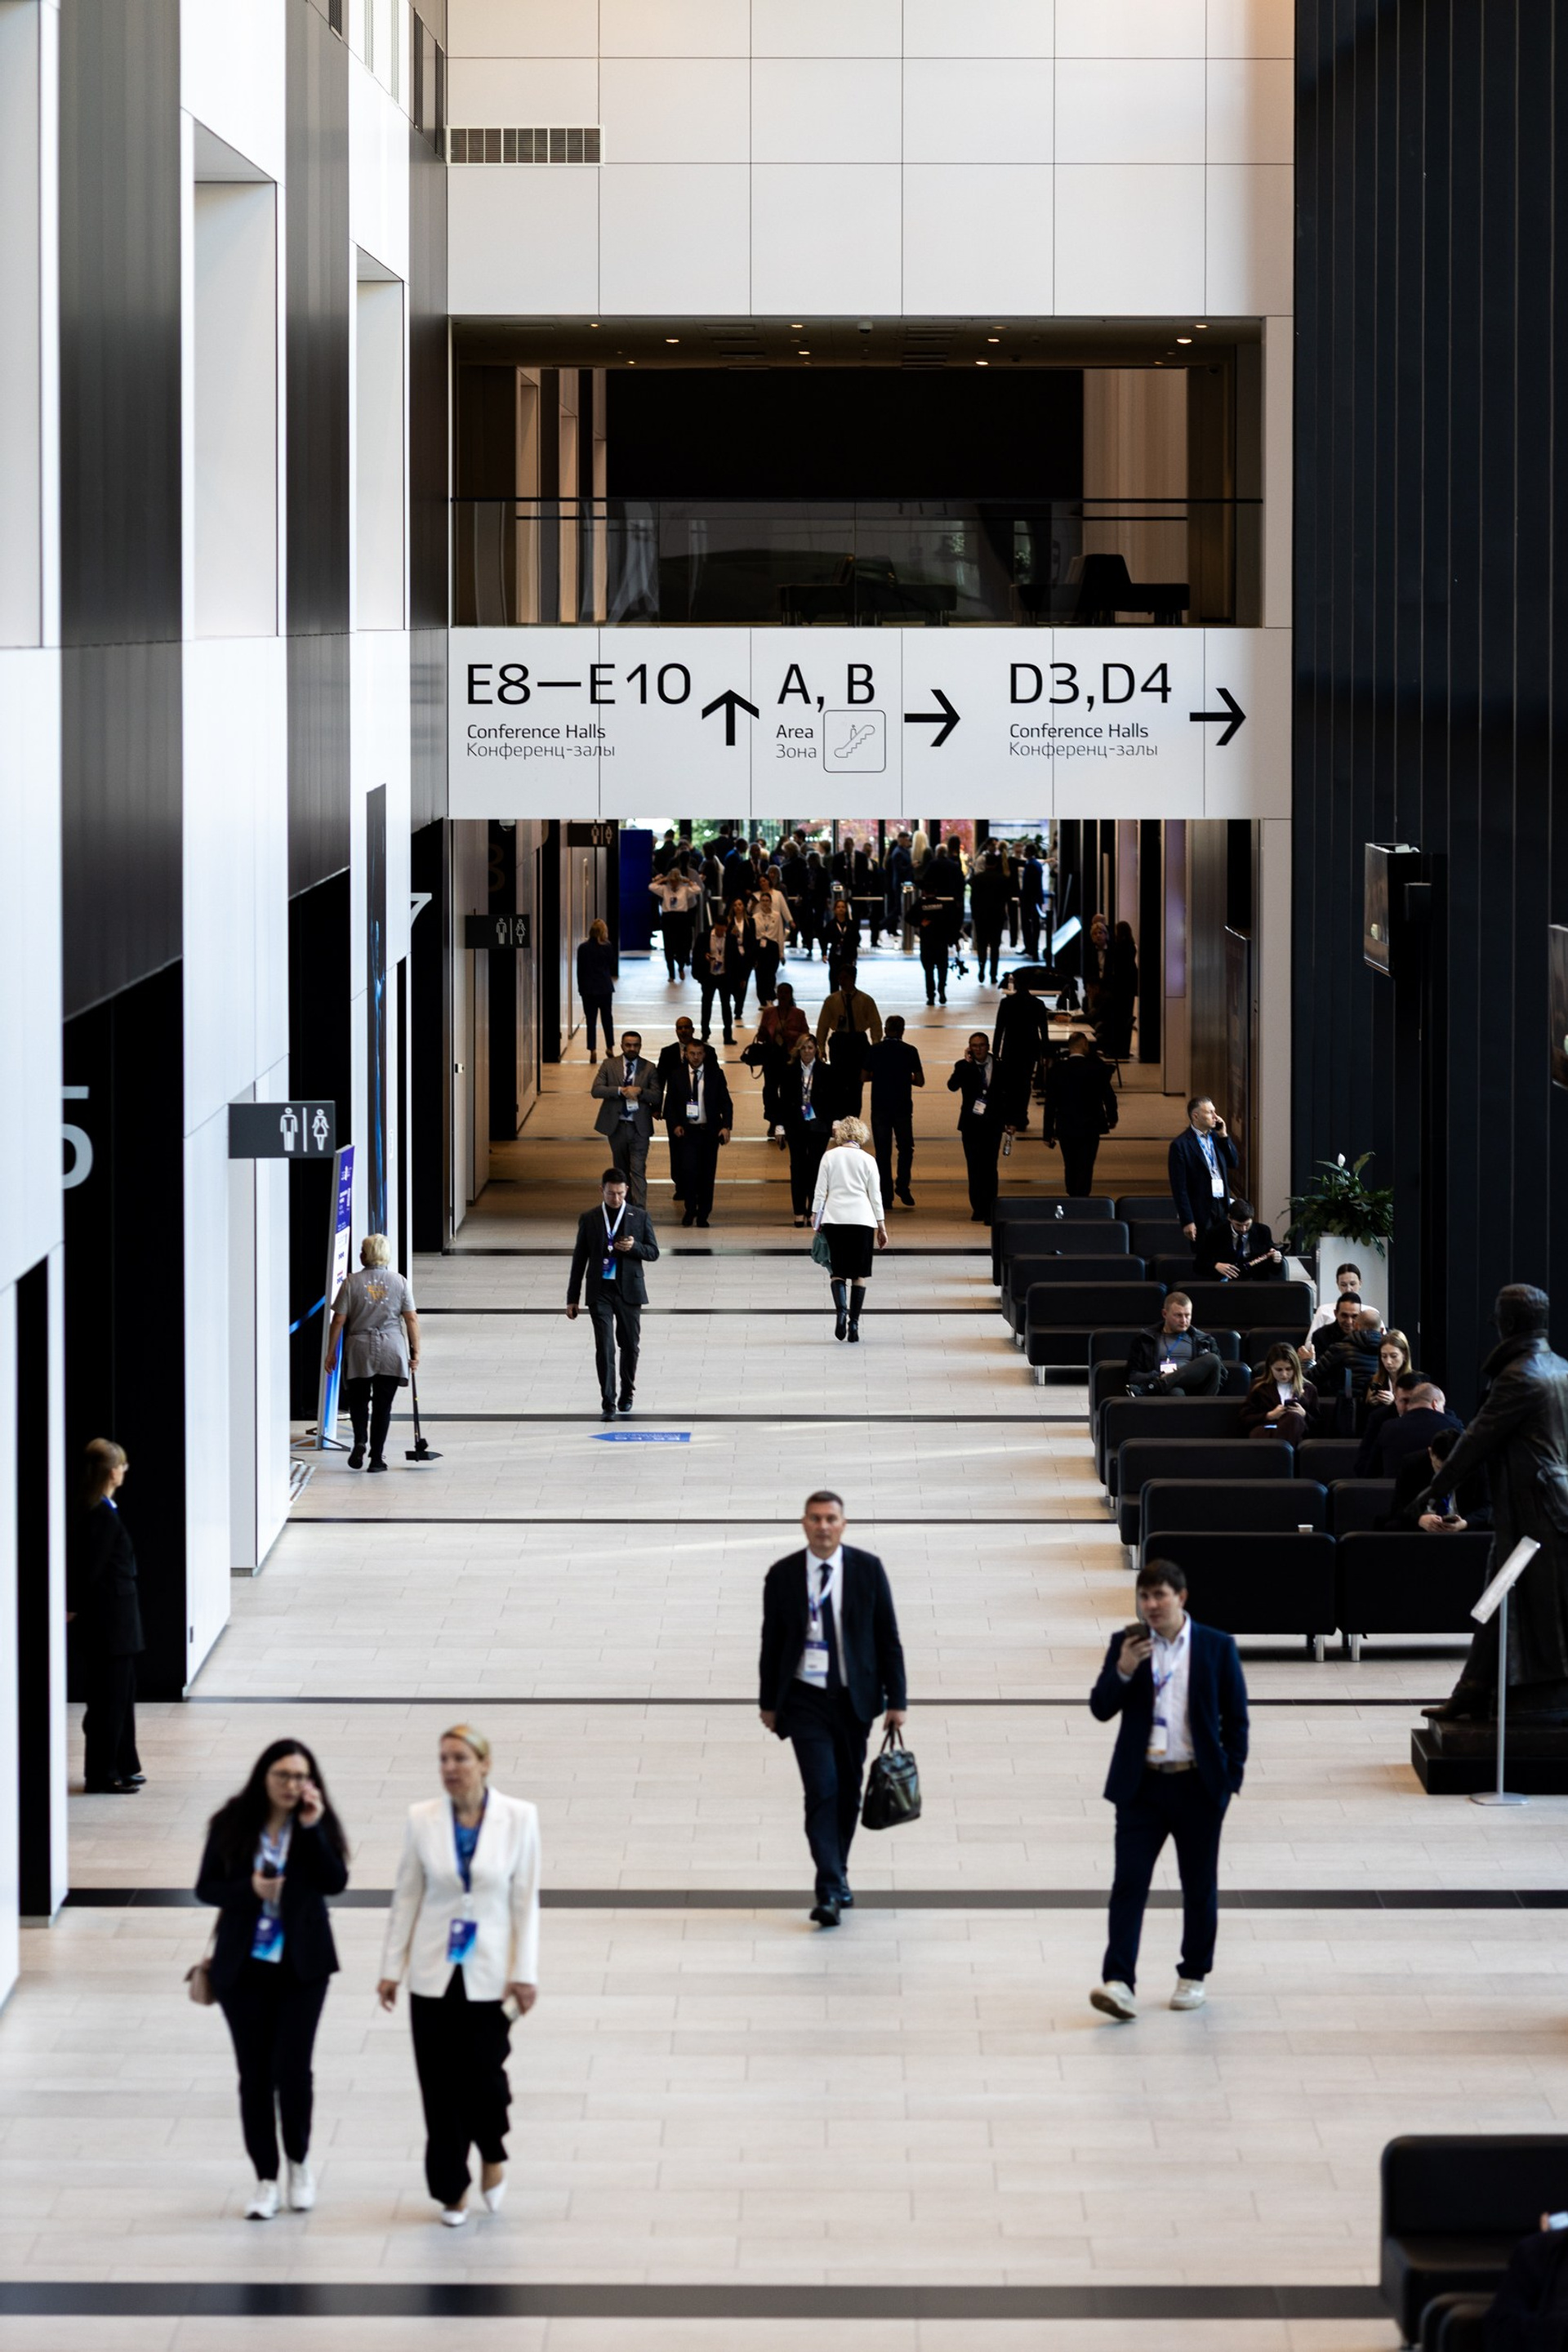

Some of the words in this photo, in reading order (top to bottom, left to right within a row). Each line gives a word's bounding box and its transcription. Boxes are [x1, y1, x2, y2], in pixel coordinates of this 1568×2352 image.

[777, 663, 825, 713] A,
[847, 663, 875, 705] B
[1009, 662, 1173, 712] D3,D4
[467, 724, 560, 739] Conference
[566, 724, 606, 739] Halls
[776, 724, 814, 739] Area
[1009, 723, 1103, 738] Conference
[1108, 723, 1149, 738] Halls
[466, 742, 615, 760] Конференц-залы
[776, 744, 817, 759] Зона
[1009, 742, 1158, 759] Конференц-залы
